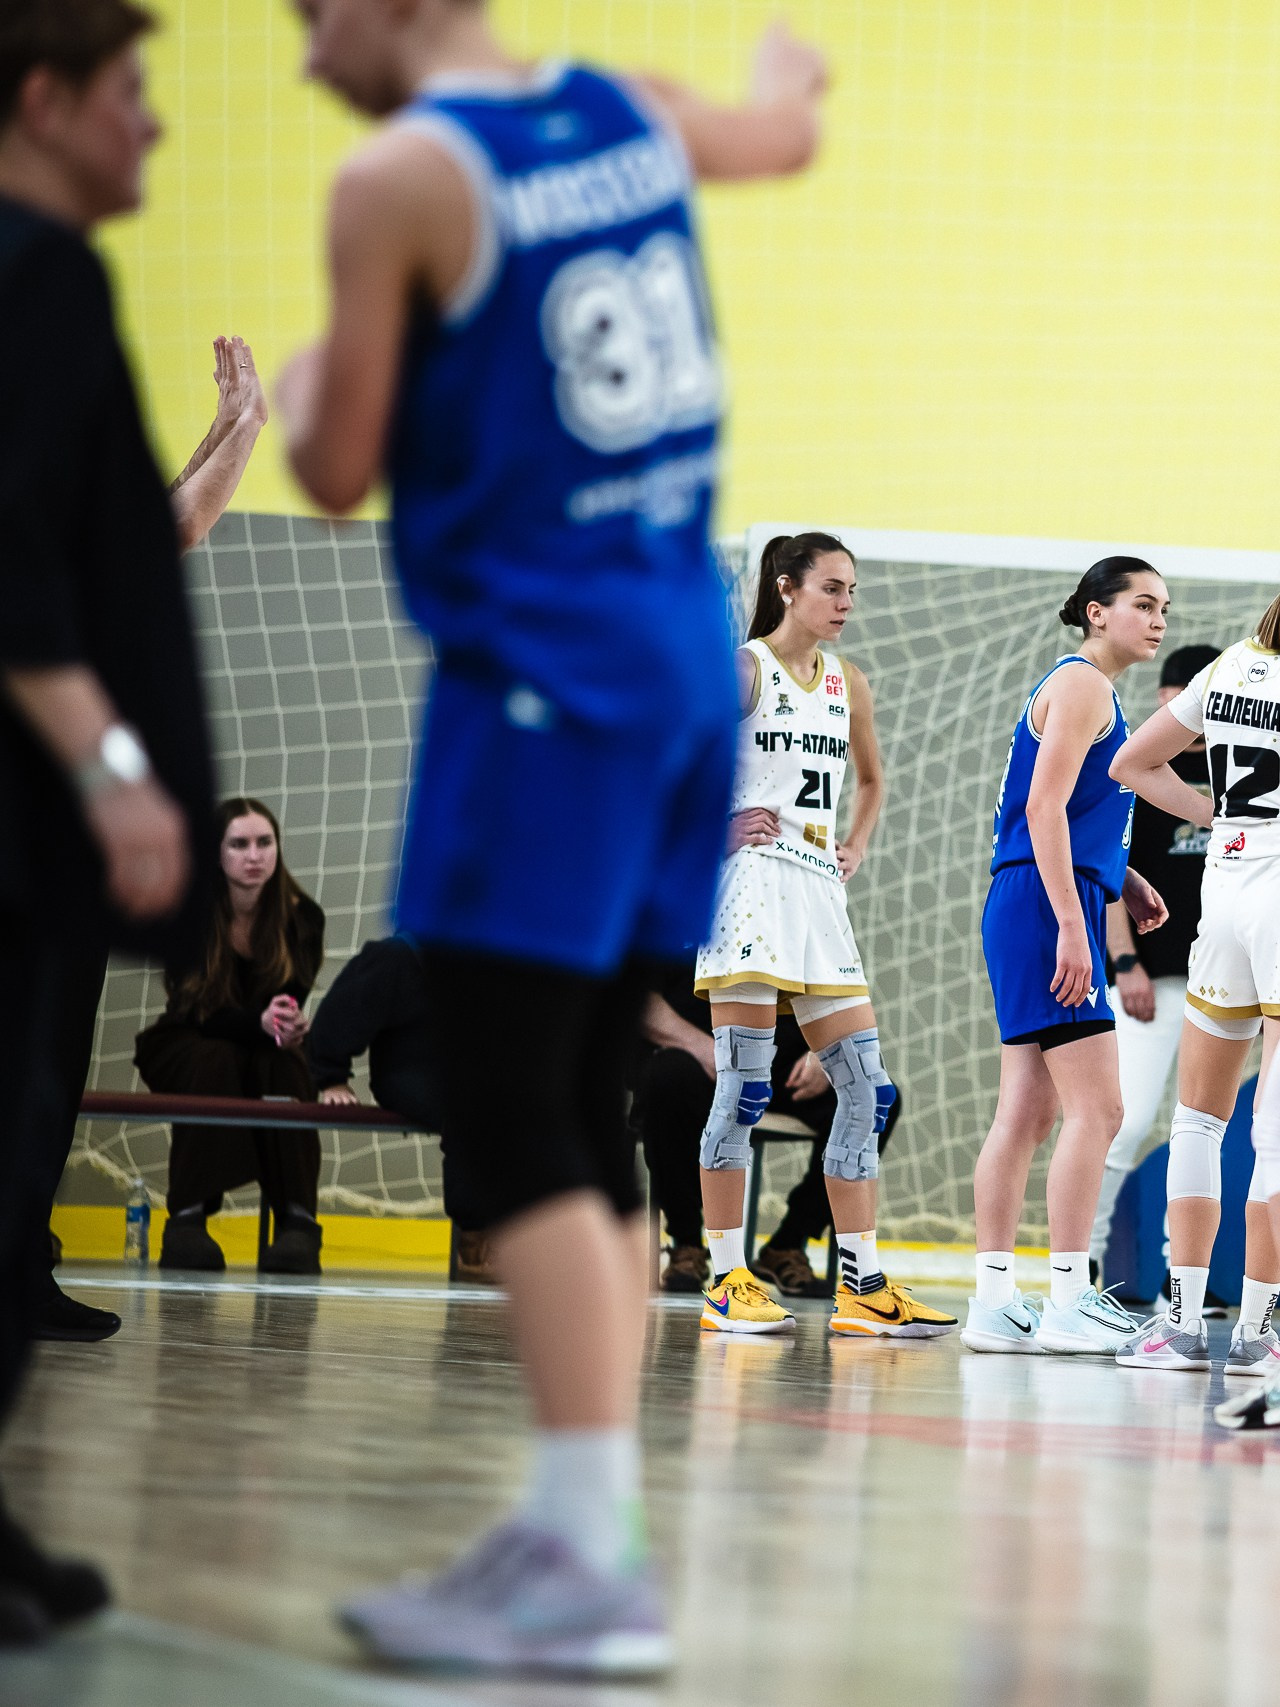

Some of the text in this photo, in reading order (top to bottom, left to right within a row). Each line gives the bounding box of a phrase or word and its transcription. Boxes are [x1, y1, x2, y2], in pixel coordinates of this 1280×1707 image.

[1250, 667, 1266, 676] РФБ
[794, 768, 832, 810] 21
[1209, 743, 1280, 819] 12
[1170, 1277, 1182, 1324] UNDER
